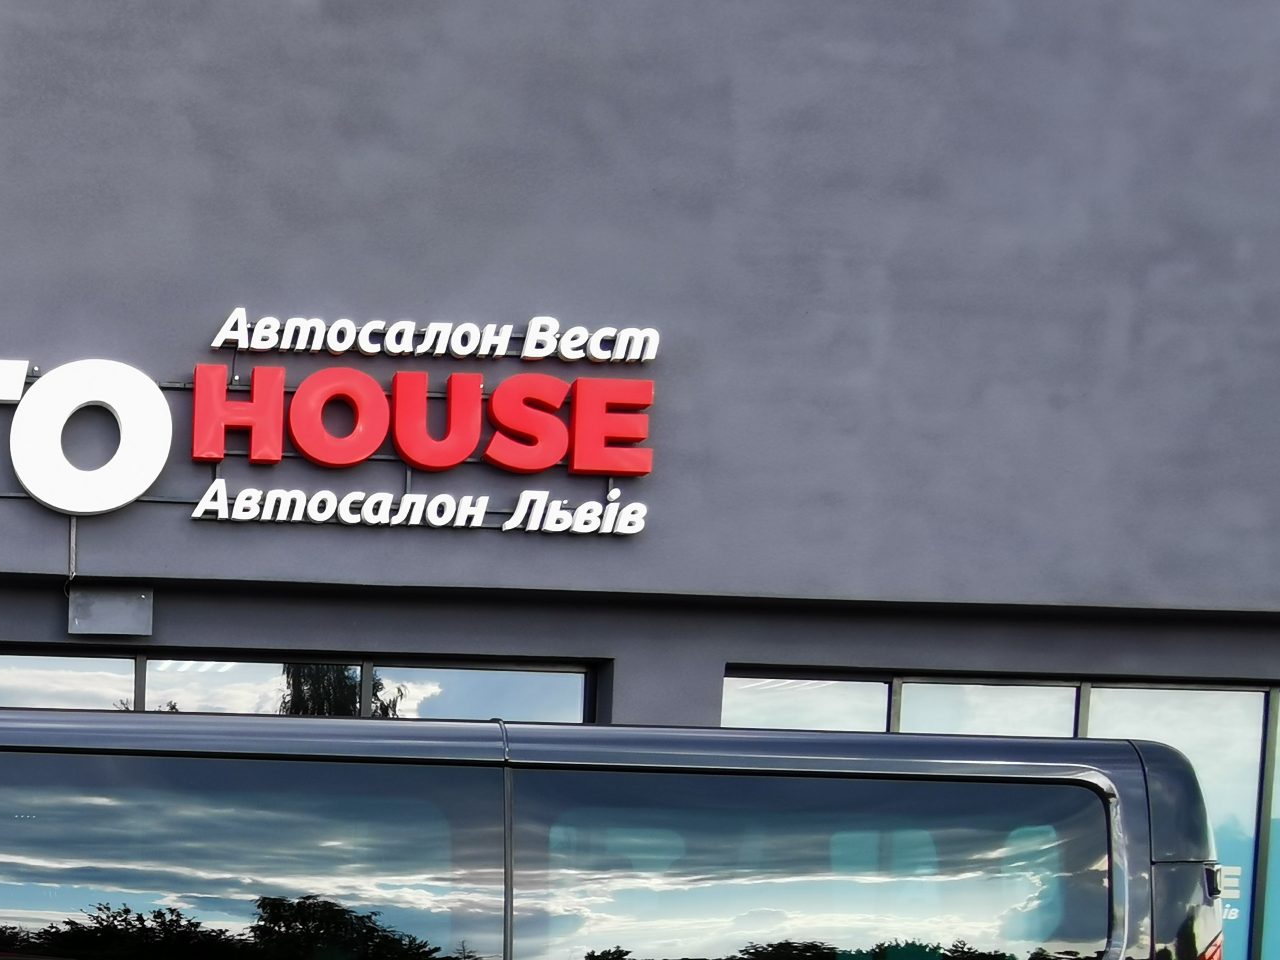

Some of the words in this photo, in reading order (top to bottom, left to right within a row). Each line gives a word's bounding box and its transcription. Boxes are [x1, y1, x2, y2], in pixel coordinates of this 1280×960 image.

[210, 306, 513, 359] Автосалон
[520, 314, 661, 363] Вест
[191, 362, 656, 478] HOUSE
[191, 478, 490, 532] Автосалон
[500, 487, 648, 536] Львів
